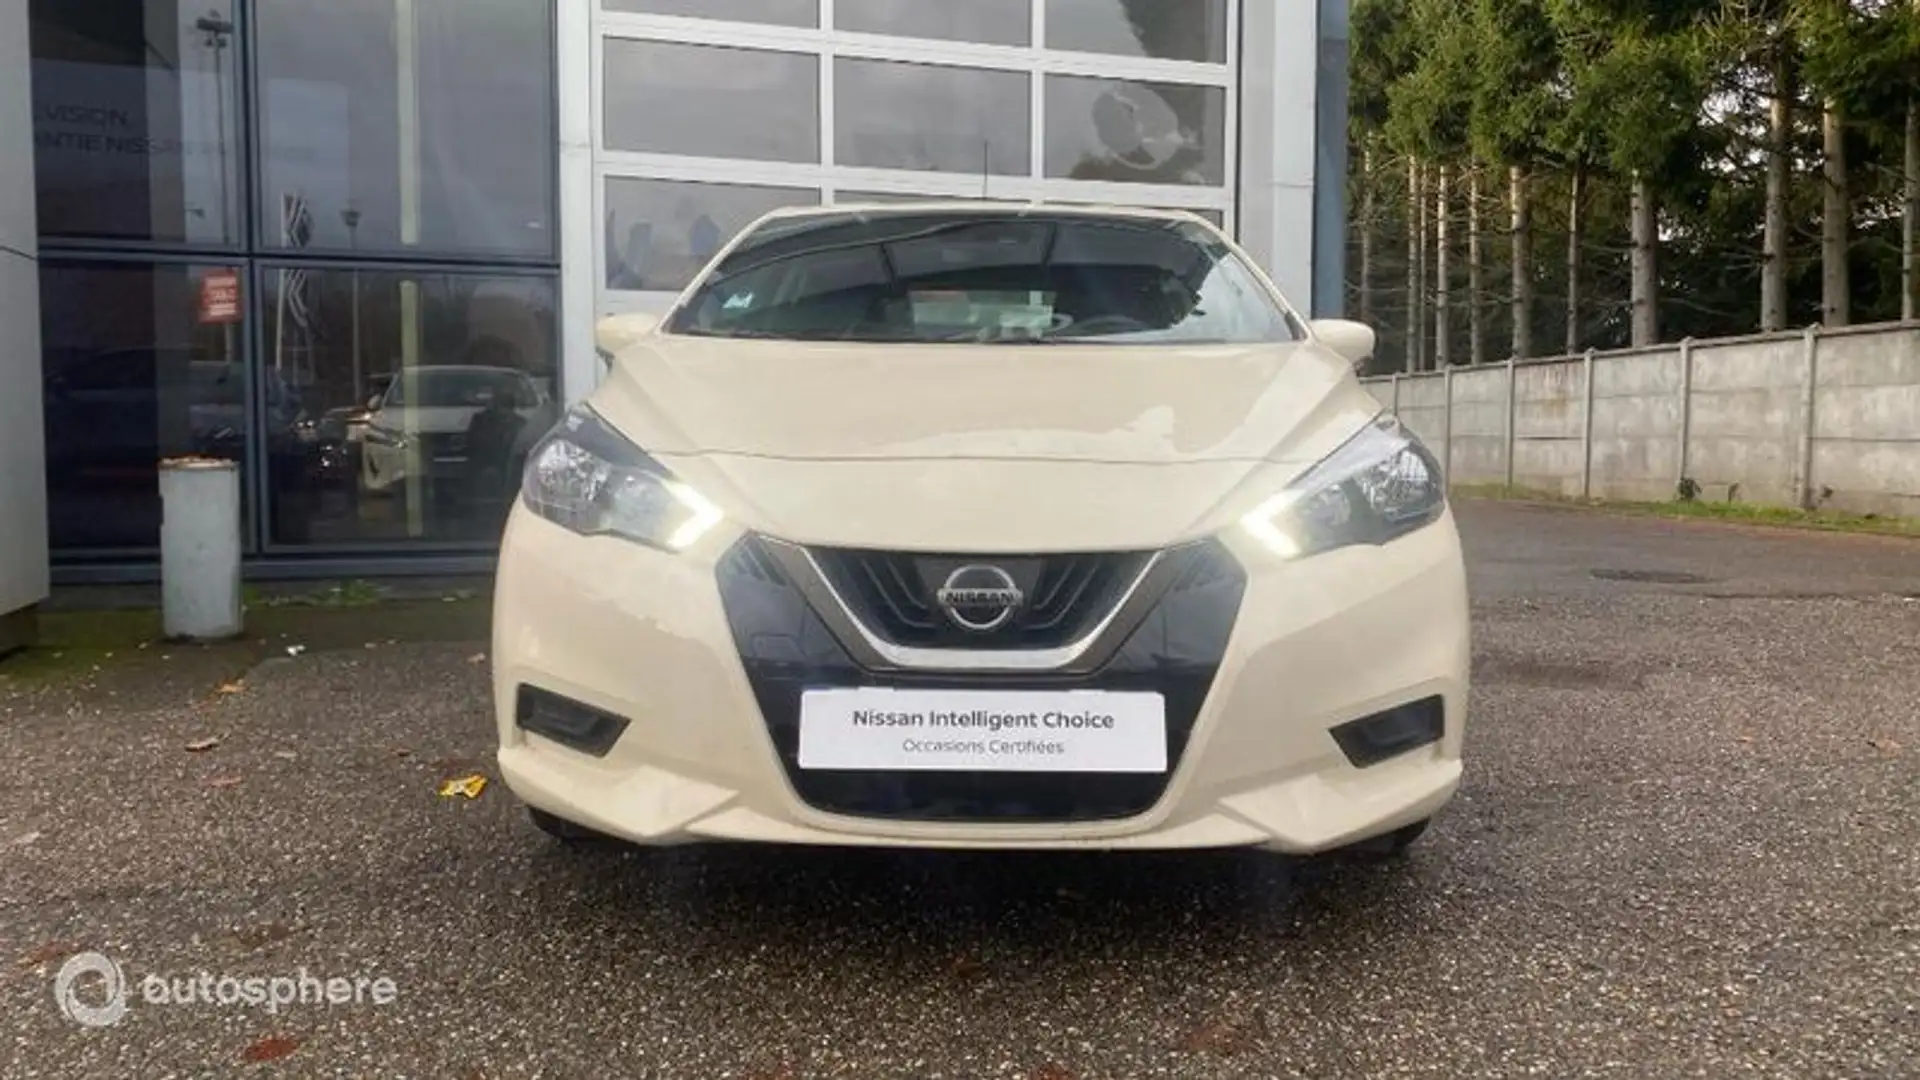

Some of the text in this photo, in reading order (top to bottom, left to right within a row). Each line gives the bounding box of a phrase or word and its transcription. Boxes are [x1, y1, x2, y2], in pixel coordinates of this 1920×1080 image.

[944, 590, 1016, 604] NISSAN
[853, 709, 1115, 732] Nissan Intelligent Choice
[902, 738, 1065, 755] Occasions Certifiées
